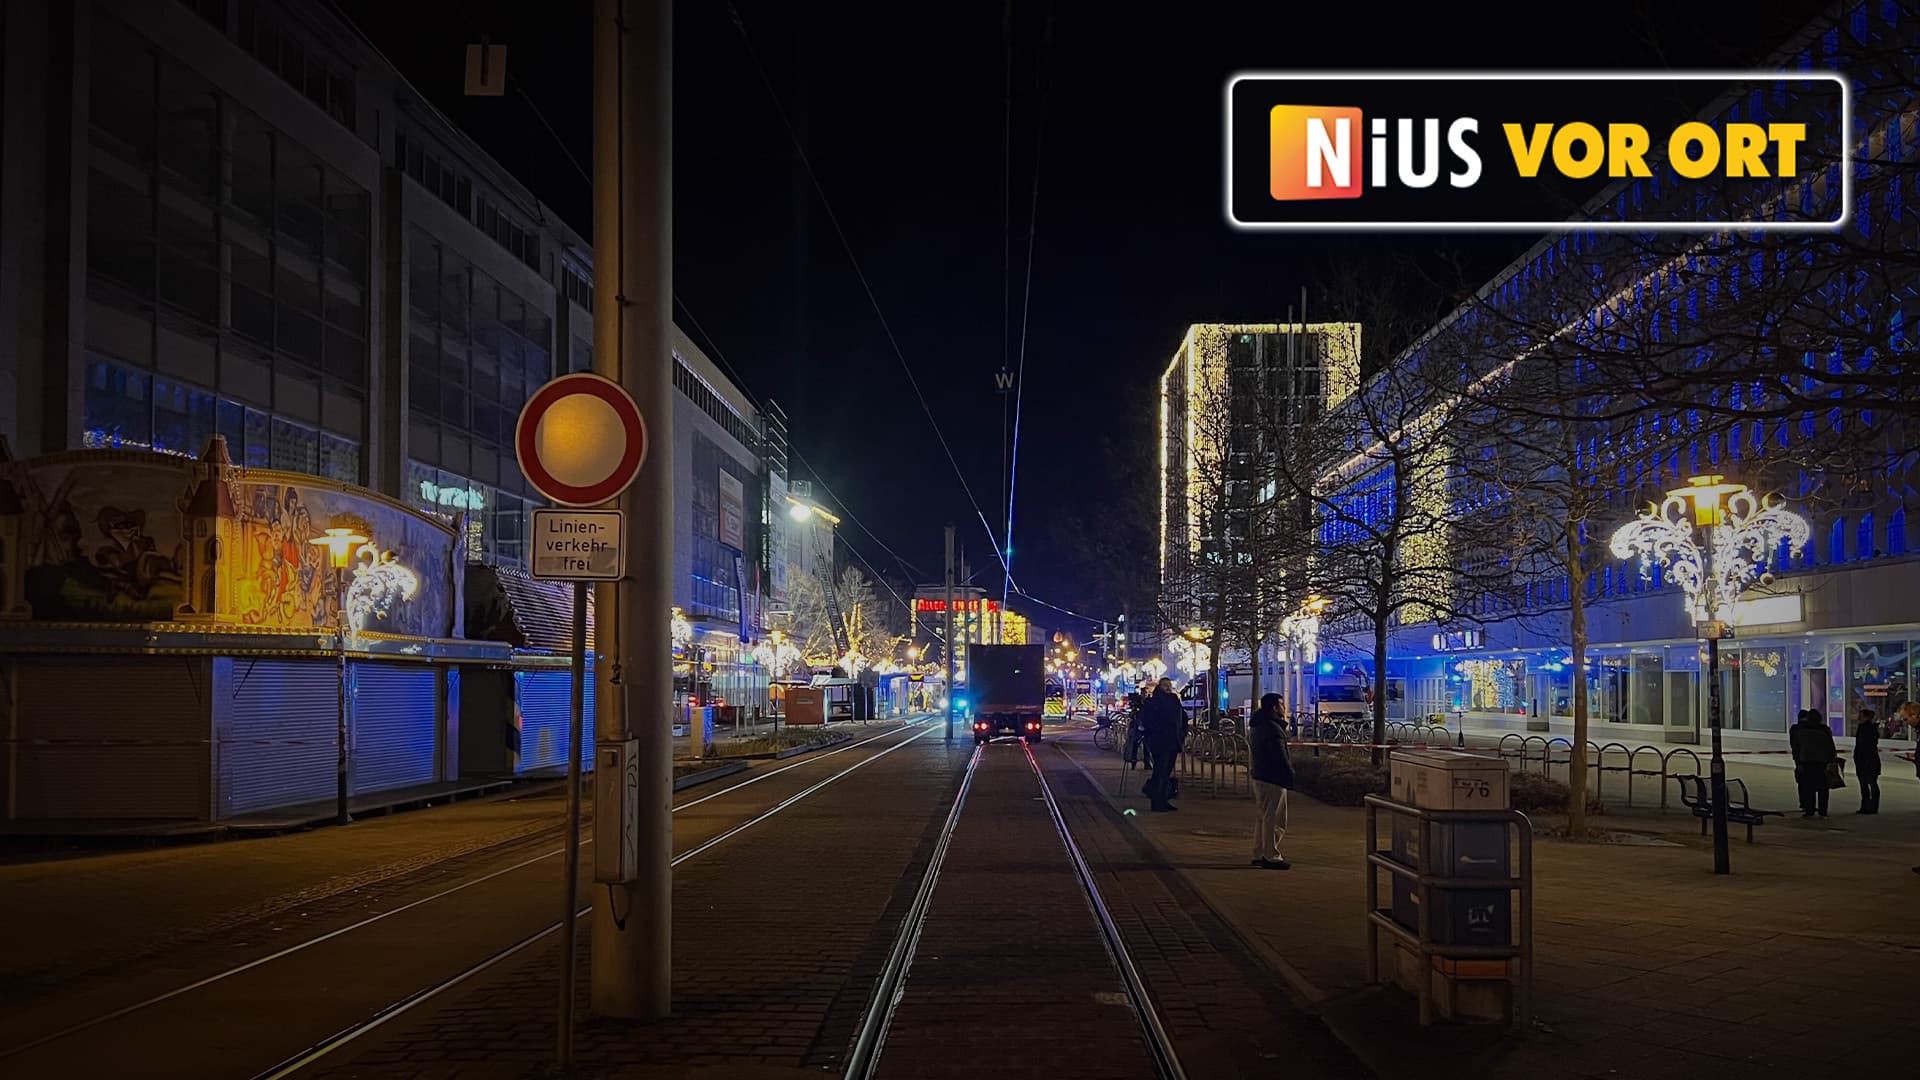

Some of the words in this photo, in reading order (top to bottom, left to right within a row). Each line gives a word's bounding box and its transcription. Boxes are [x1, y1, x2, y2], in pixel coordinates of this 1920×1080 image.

[995, 372, 1014, 389] W
[549, 519, 605, 534] Linien-
[546, 538, 609, 553] verkehr
[563, 556, 590, 571] frei
